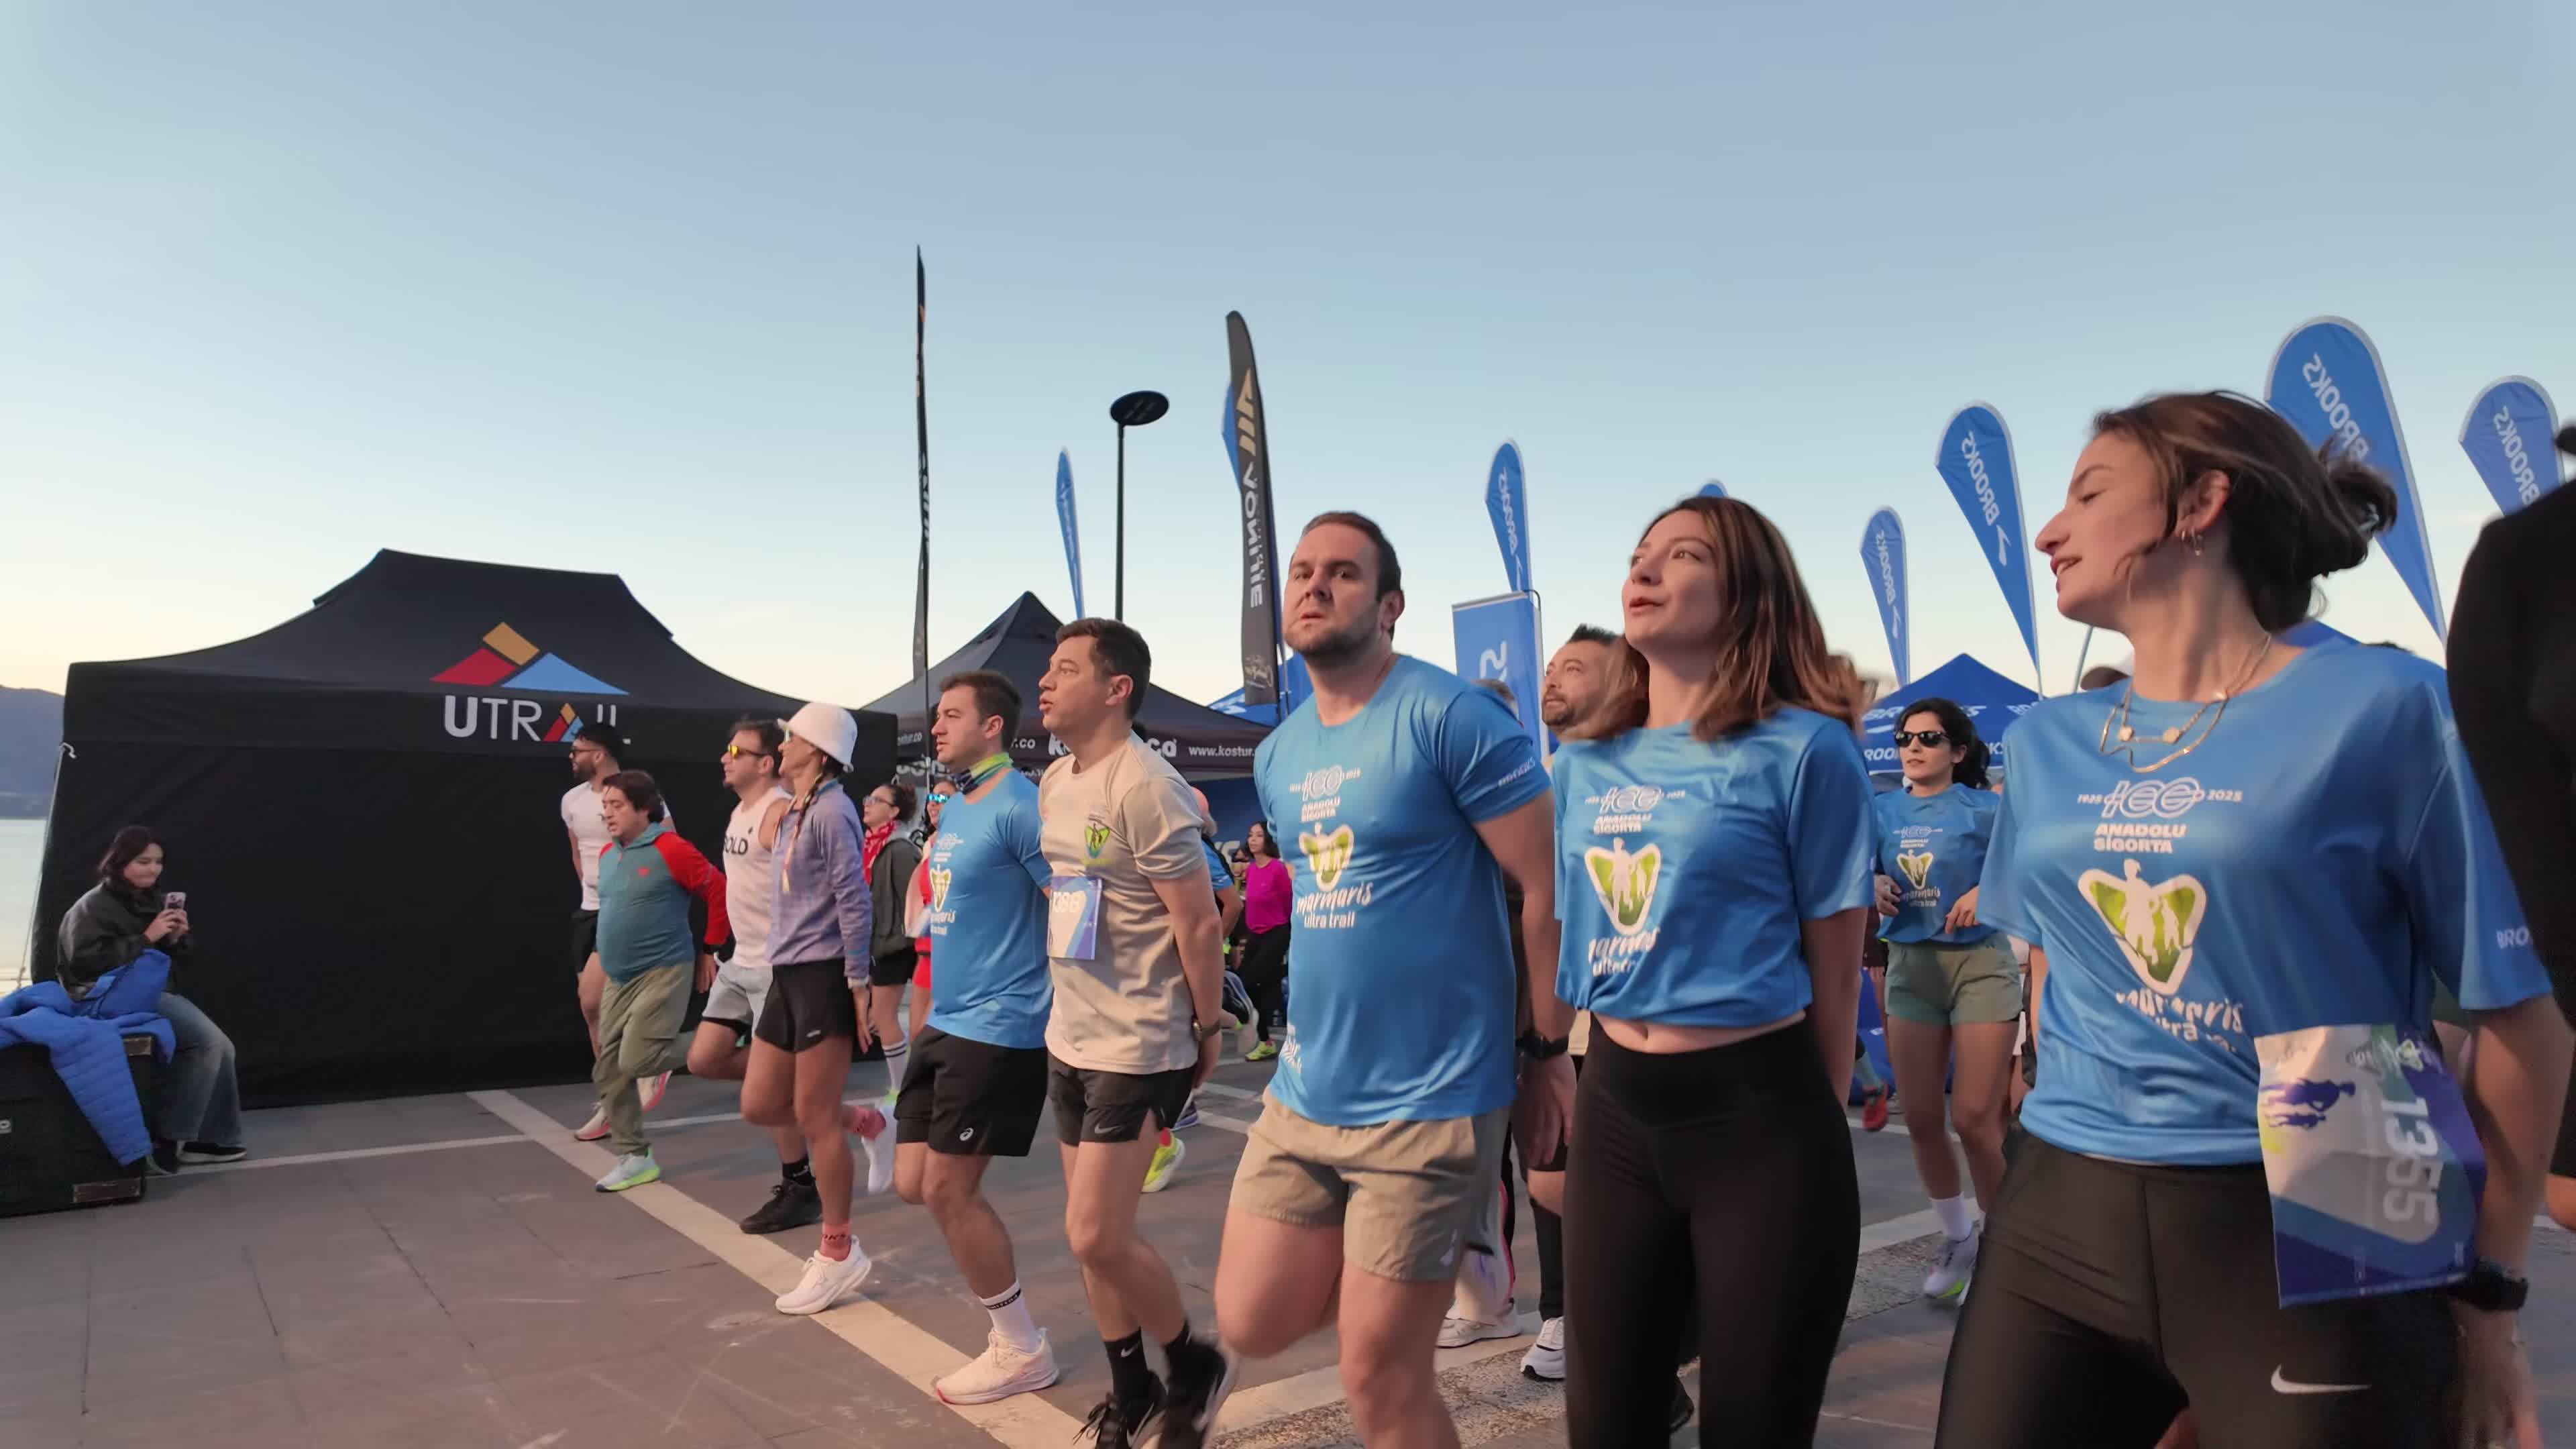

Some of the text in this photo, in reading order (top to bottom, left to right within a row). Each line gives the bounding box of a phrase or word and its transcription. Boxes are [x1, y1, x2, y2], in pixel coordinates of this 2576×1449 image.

[2094, 823, 2187, 838] ANADOLU
[1296, 881, 1373, 916] marmaris
[2381, 1096, 2444, 1225] 1355
